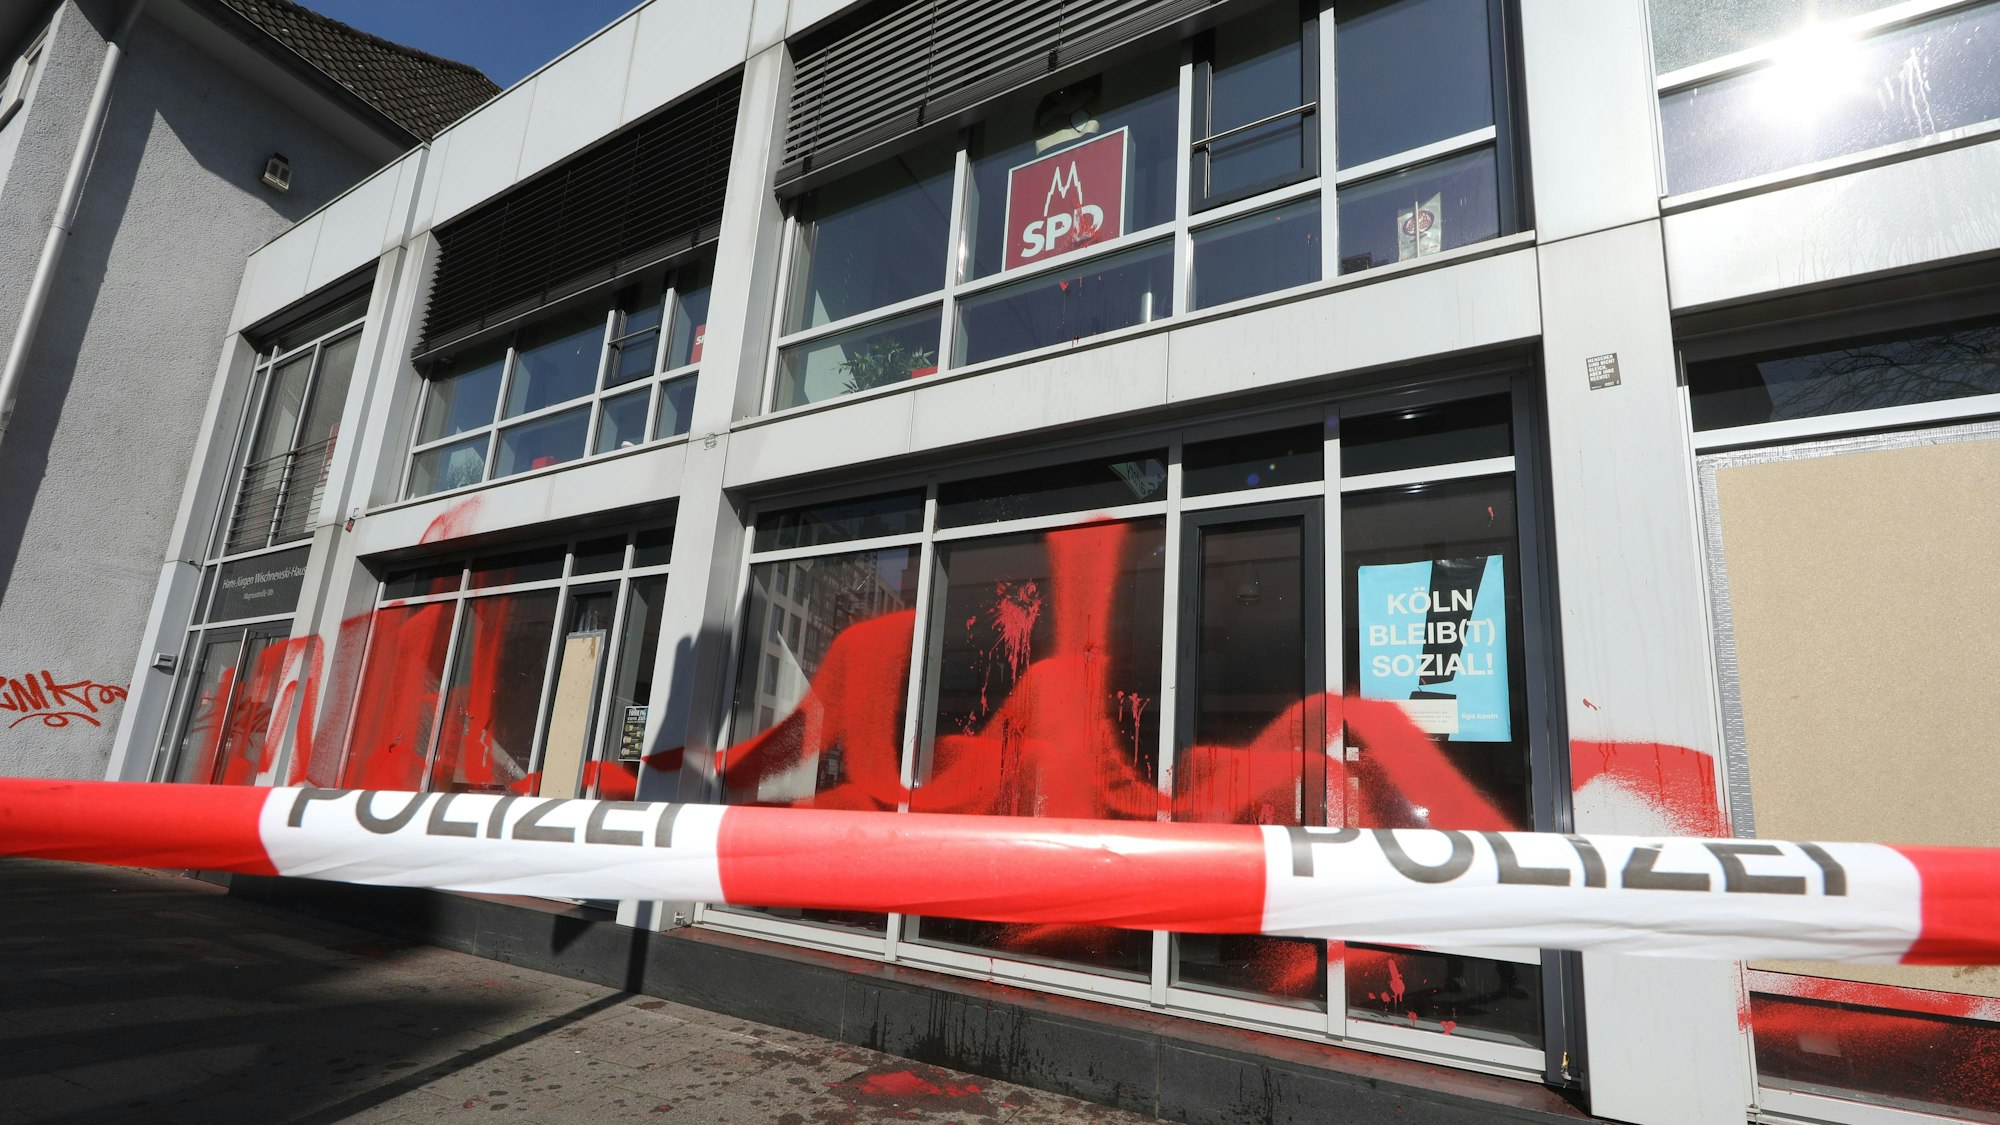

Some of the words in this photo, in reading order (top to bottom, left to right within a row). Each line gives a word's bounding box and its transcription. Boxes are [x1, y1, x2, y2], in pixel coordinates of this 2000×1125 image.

[1020, 204, 1104, 258] SPD
[222, 576, 254, 589] Hans-Jürgen
[1387, 586, 1473, 615] KÖLN
[1369, 618, 1495, 646] BLEIB(T)
[1372, 653, 1494, 678] SOZIAL!
[1461, 712, 1499, 720] liga.koeln
